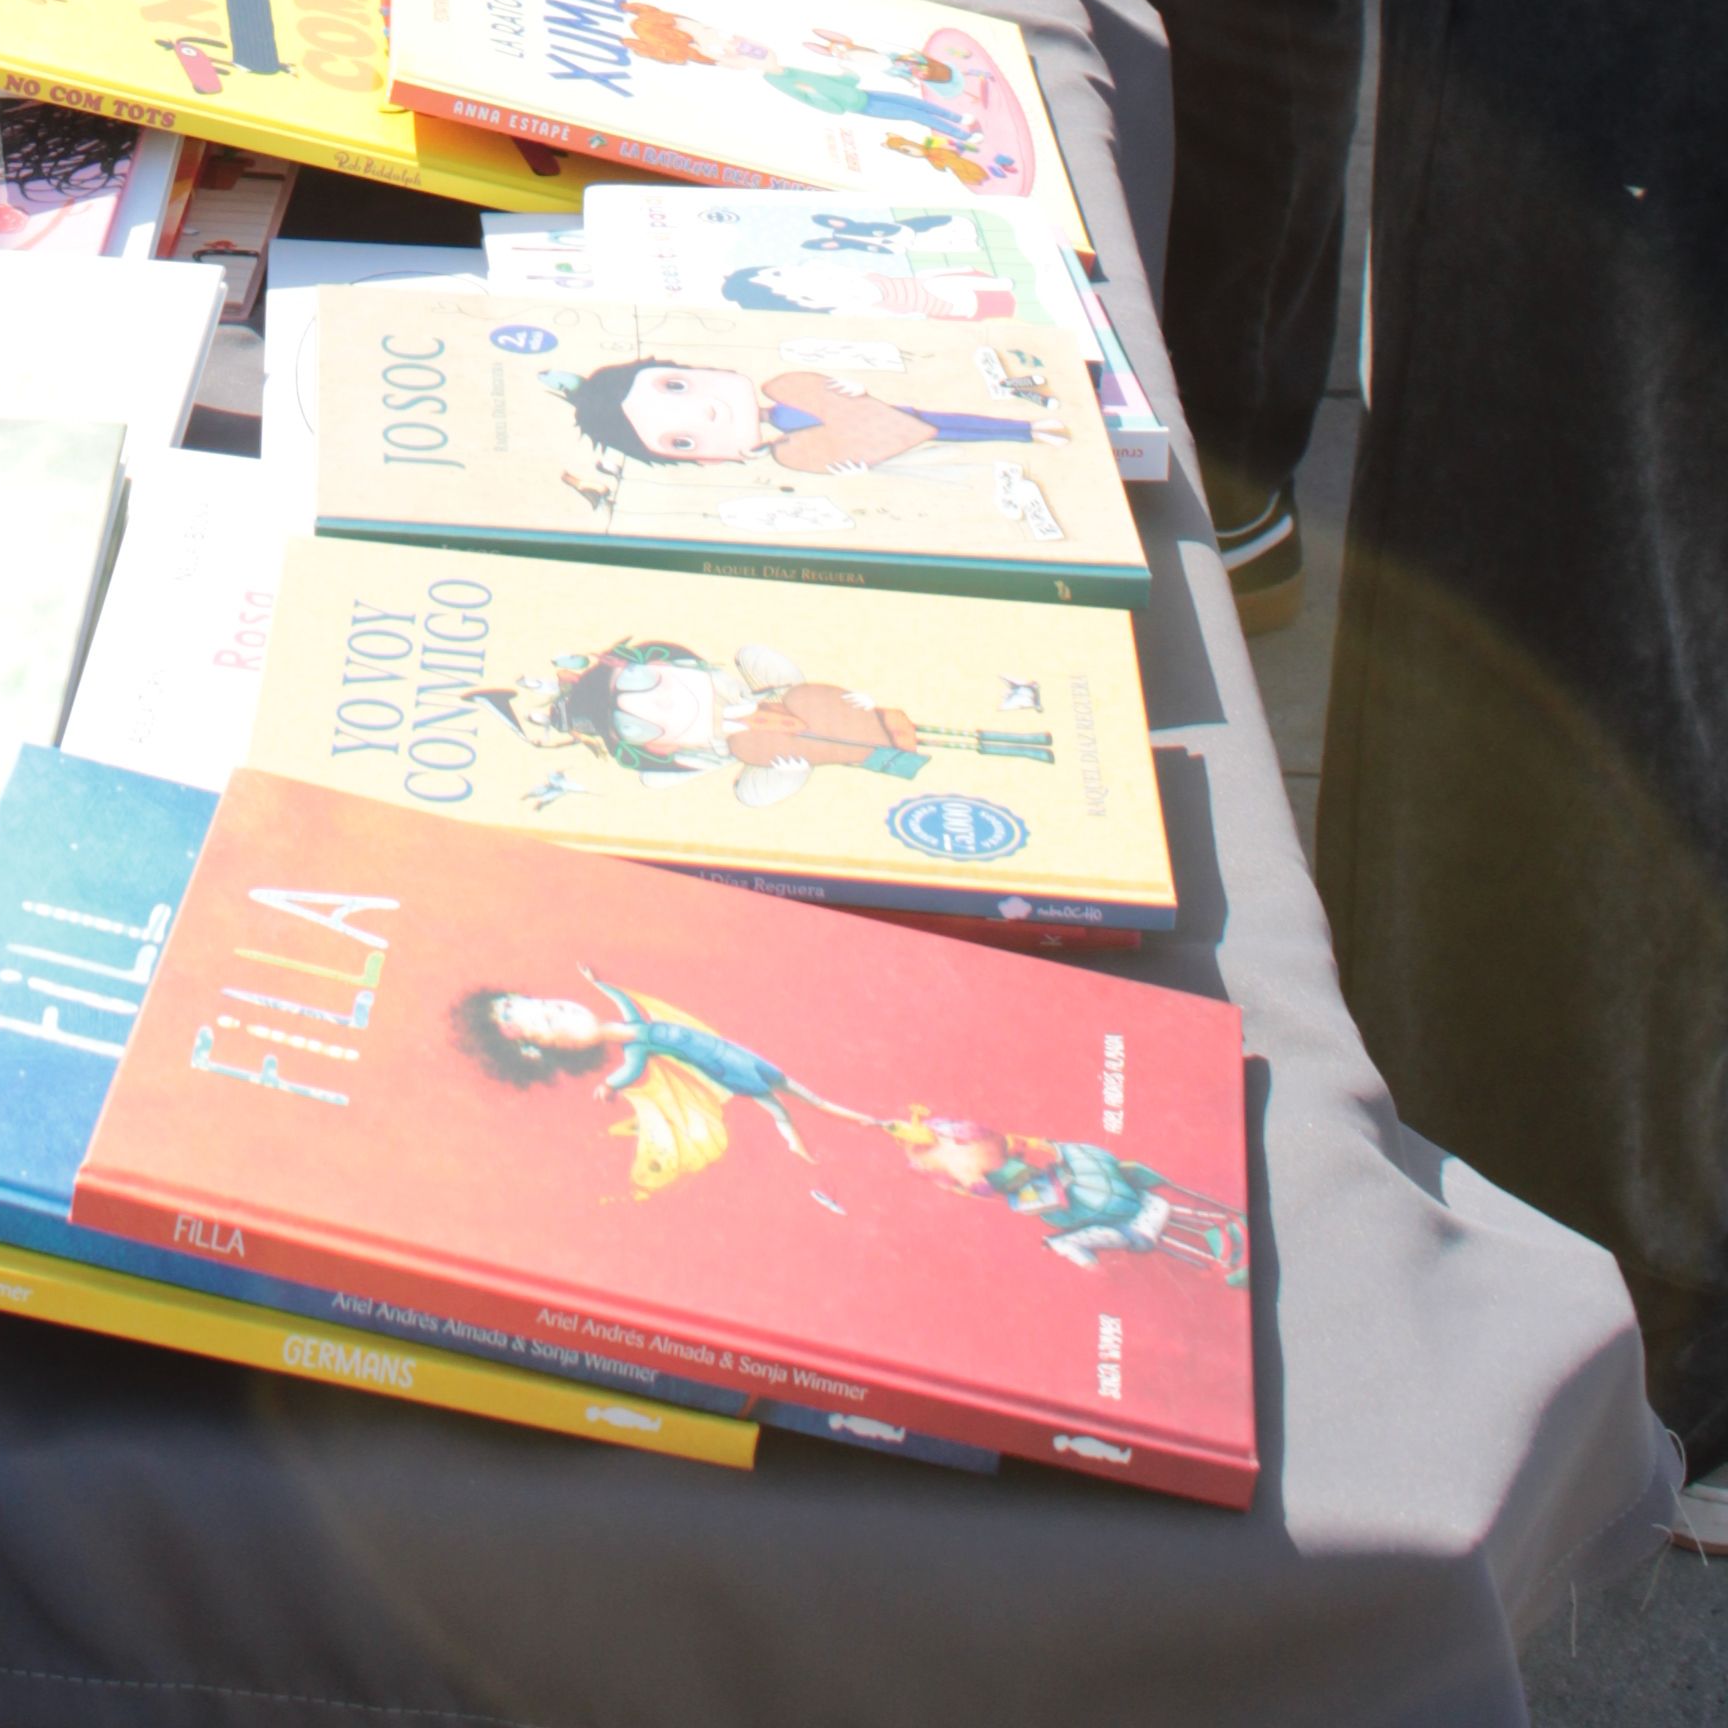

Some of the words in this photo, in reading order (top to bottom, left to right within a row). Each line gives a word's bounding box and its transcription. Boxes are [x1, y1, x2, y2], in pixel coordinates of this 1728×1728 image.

[490, 38, 525, 58] LA
[4, 73, 42, 97] NO
[48, 84, 103, 113] COM
[113, 100, 177, 129] TOTS
[453, 100, 501, 124] ANNA
[619, 141, 641, 158] LA
[334, 150, 363, 172] Rob
[363, 157, 423, 188] Biddulph
[380, 333, 449, 416] SOC
[382, 420, 466, 470] JO
[801, 565, 867, 586] REGUERA
[342, 599, 417, 687] VOY
[403, 578, 494, 803] CONMIGO
[1071, 674, 1095, 732] REGUERA
[330, 698, 405, 757] YO
[1078, 771, 1107, 818] RAQUEL
[752, 874, 827, 901] Reguera
[282, 1330, 416, 1390] GERMANS
[332, 1290, 373, 1316] Ariel
[375, 1302, 439, 1335] Andrés
[442, 1315, 508, 1349] Almada
[511, 1335, 527, 1353] &
[530, 1336, 579, 1368] Sonja
[584, 1348, 660, 1385] Wimmer
[536, 1306, 578, 1333] Ariel
[580, 1317, 645, 1351] Andrés
[649, 1331, 716, 1367] Almada
[719, 1352, 735, 1370] &
[738, 1353, 787, 1385] Sonja
[791, 1365, 870, 1402] Wimmer
